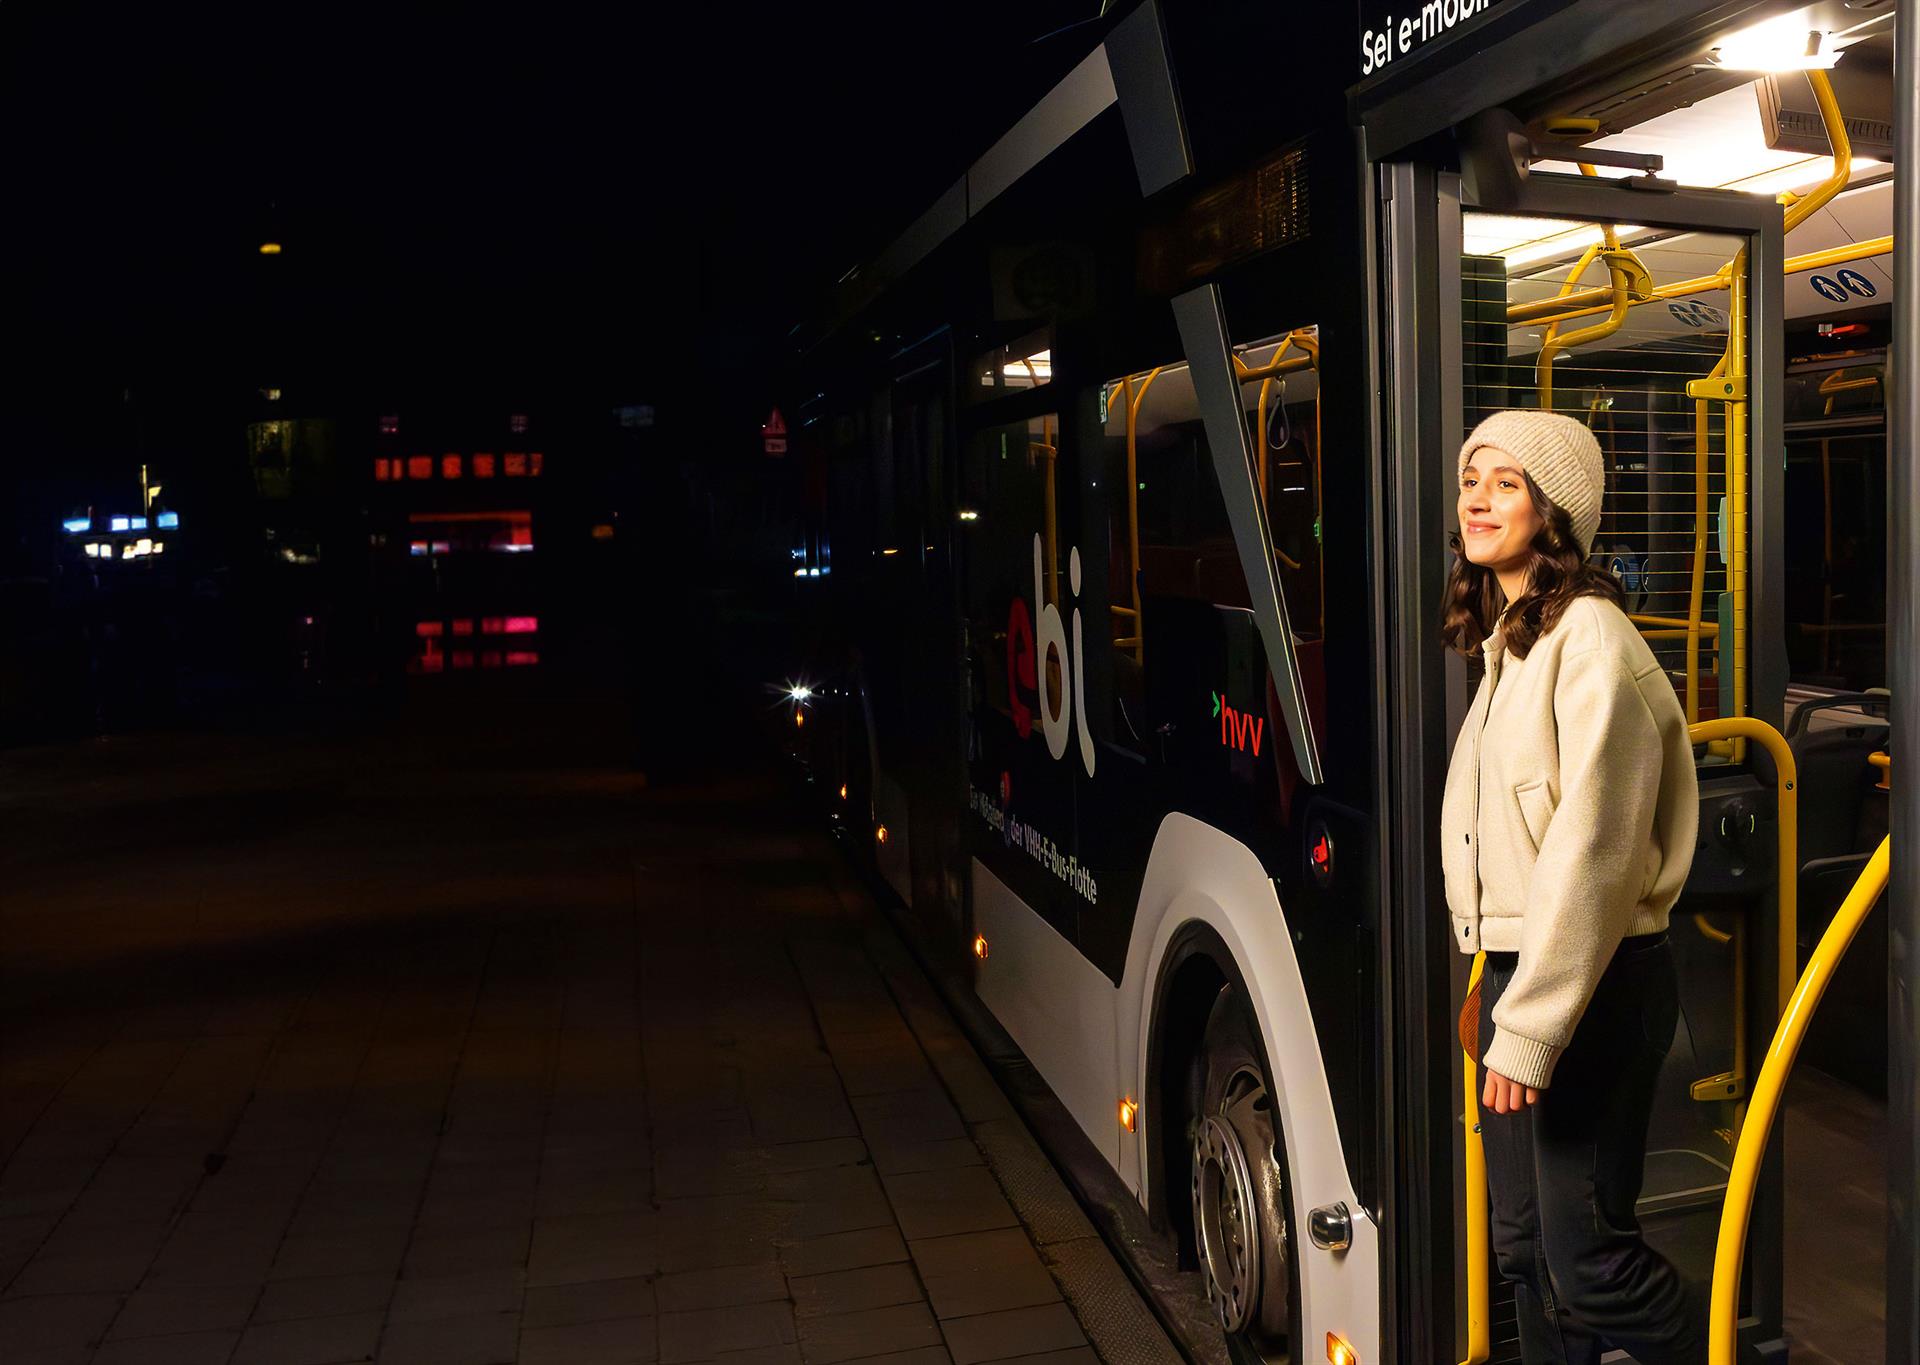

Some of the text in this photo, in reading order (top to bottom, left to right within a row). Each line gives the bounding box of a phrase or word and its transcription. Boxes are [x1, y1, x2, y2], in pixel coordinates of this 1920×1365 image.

[1362, 0, 1489, 75] Sei e-mob
[1010, 814, 1023, 847] der
